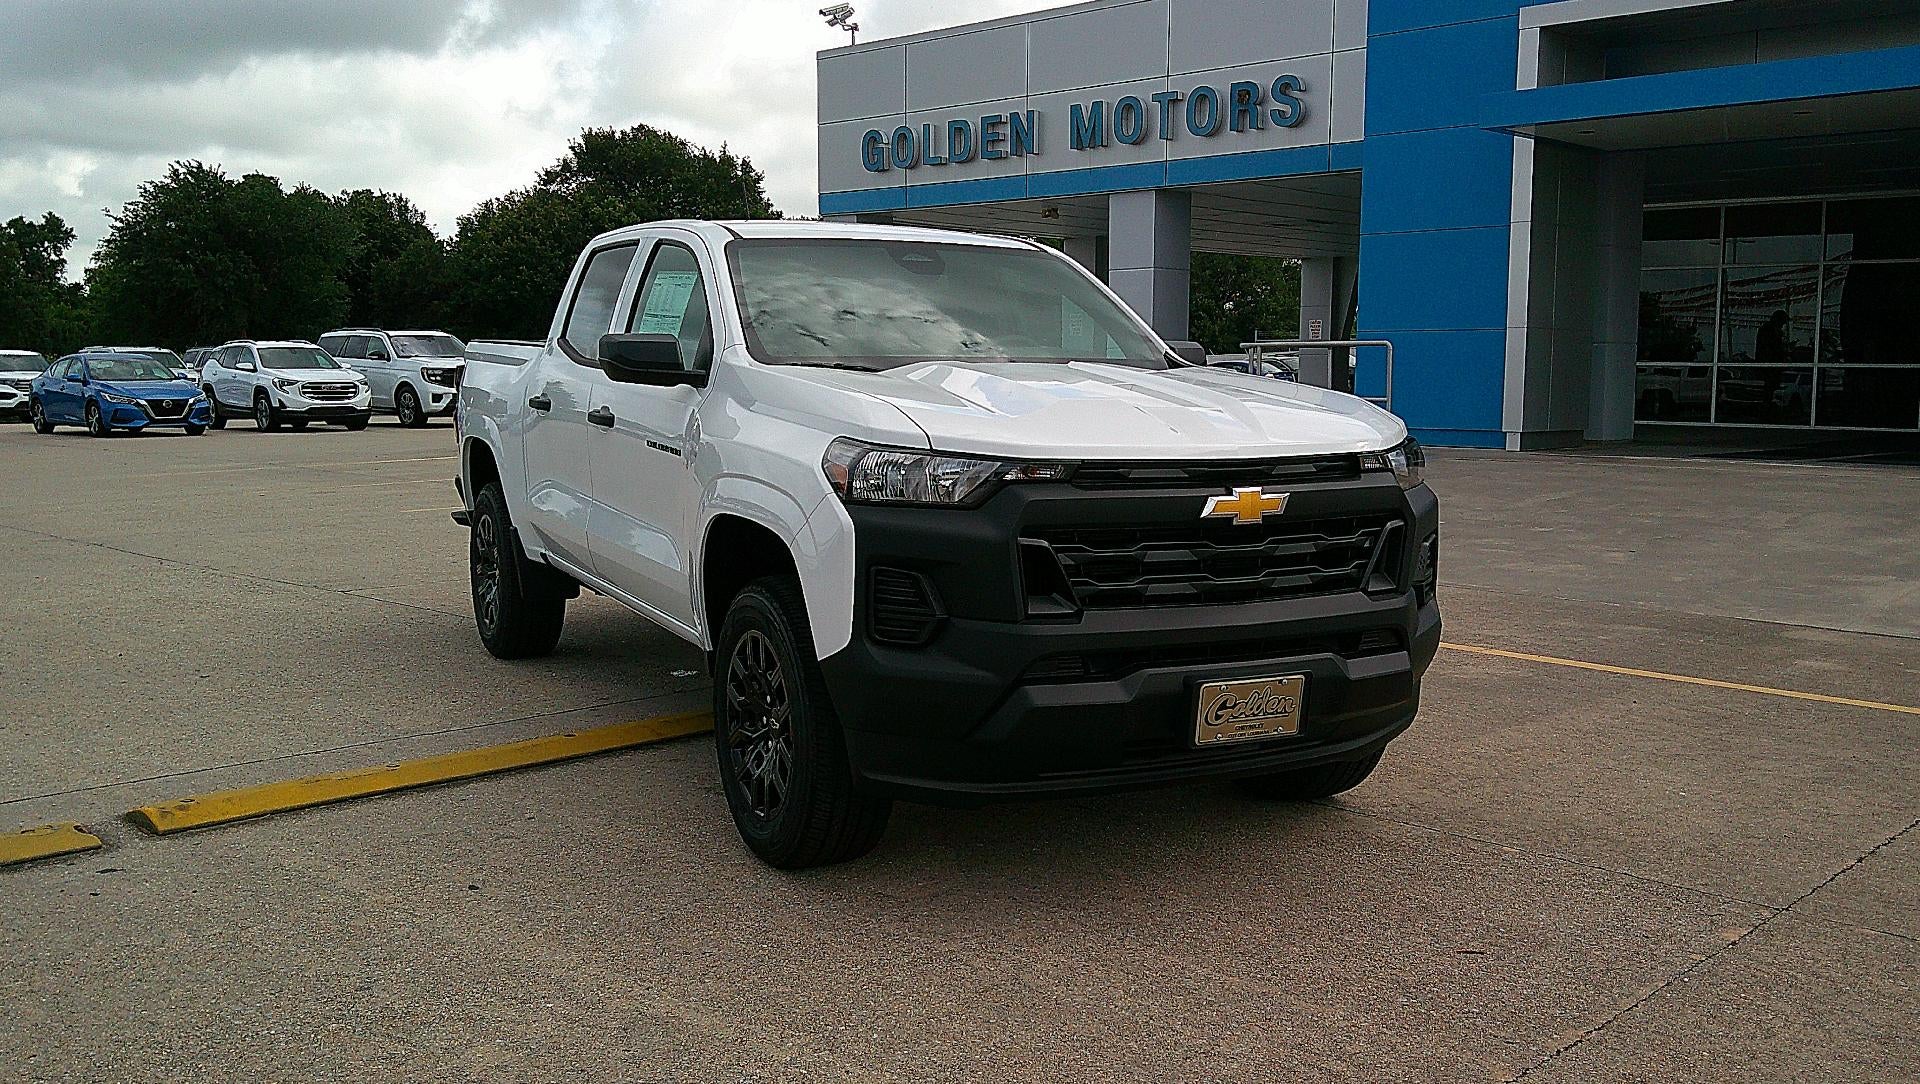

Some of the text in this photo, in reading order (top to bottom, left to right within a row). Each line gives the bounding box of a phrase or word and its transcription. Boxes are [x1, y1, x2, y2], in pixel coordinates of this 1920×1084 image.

[861, 74, 1307, 173] GOLDEN MOTORS
[1203, 685, 1296, 728] Golden
